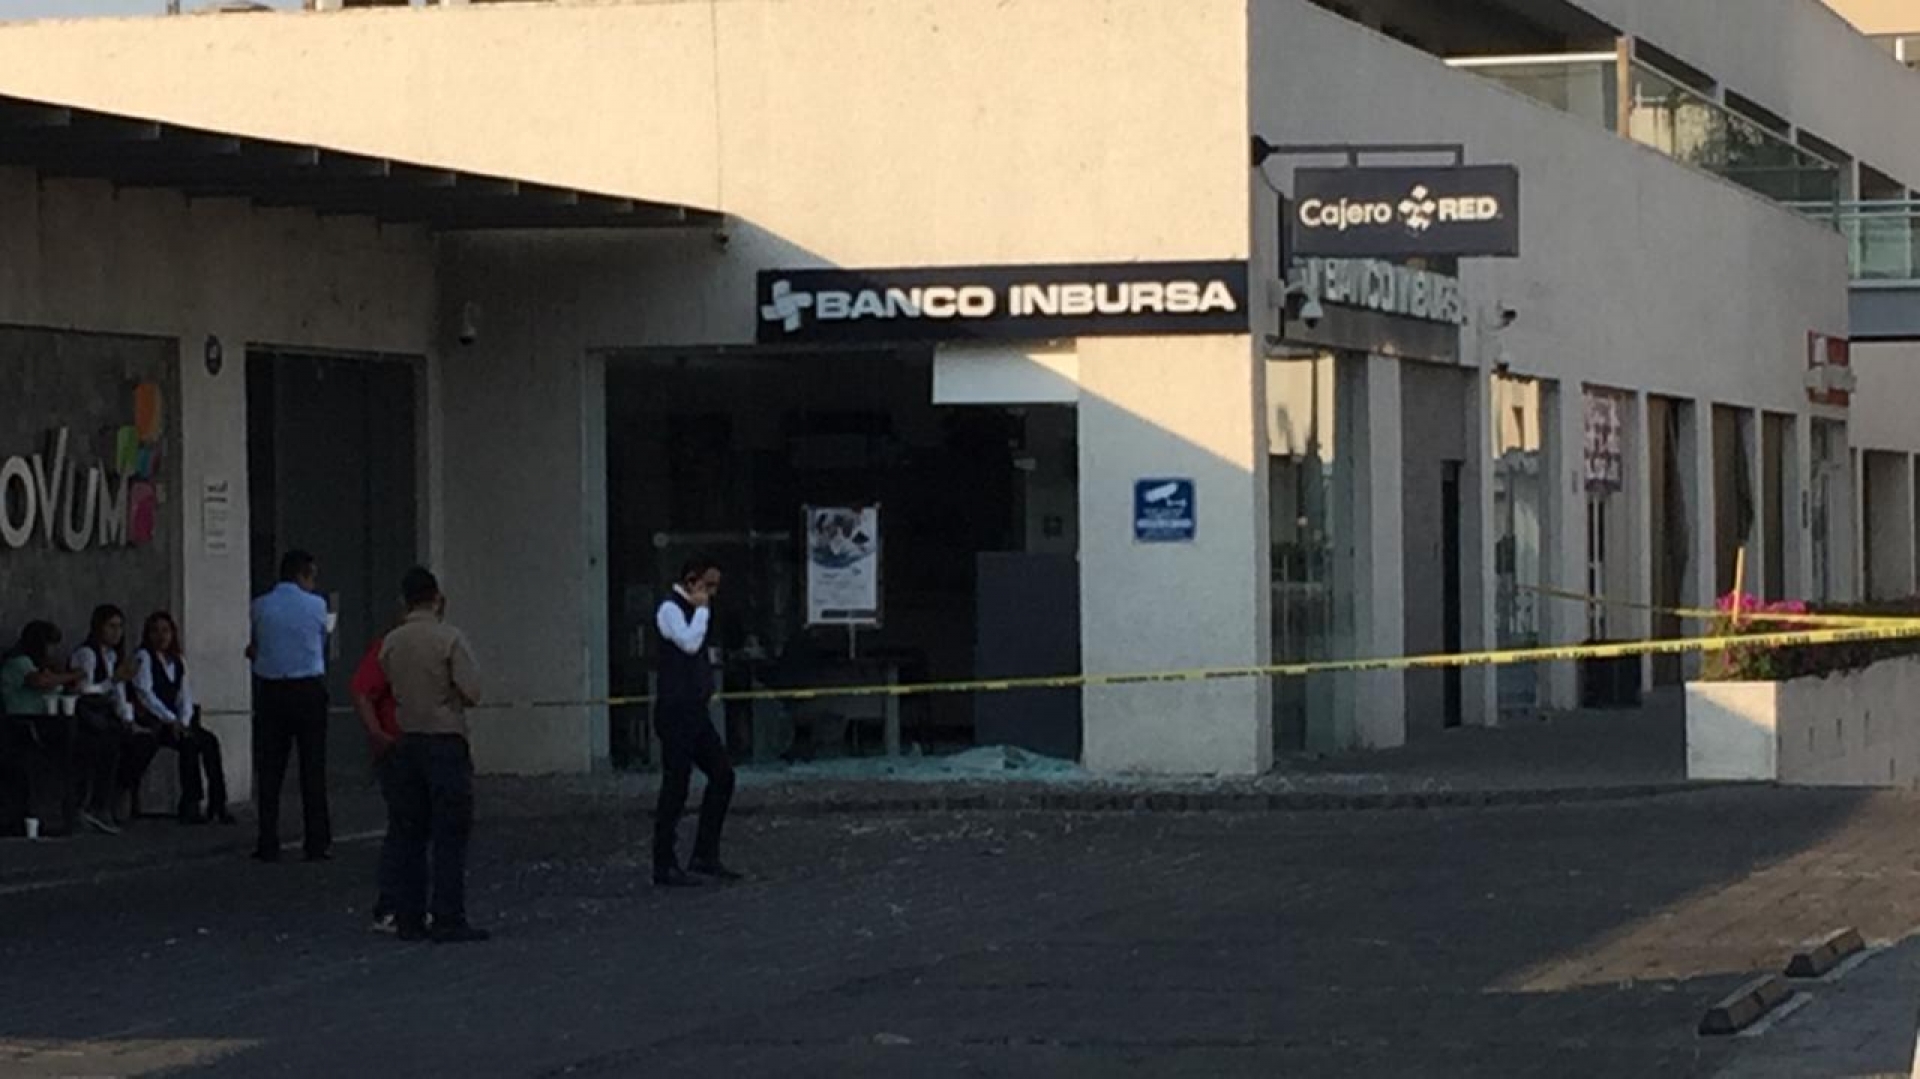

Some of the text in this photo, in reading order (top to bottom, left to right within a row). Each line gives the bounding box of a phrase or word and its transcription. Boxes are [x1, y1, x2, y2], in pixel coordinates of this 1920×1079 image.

[1299, 197, 1498, 231] Cajero RED
[815, 281, 1237, 318] BANCO INBURSA
[0, 427, 129, 551] OVUM
